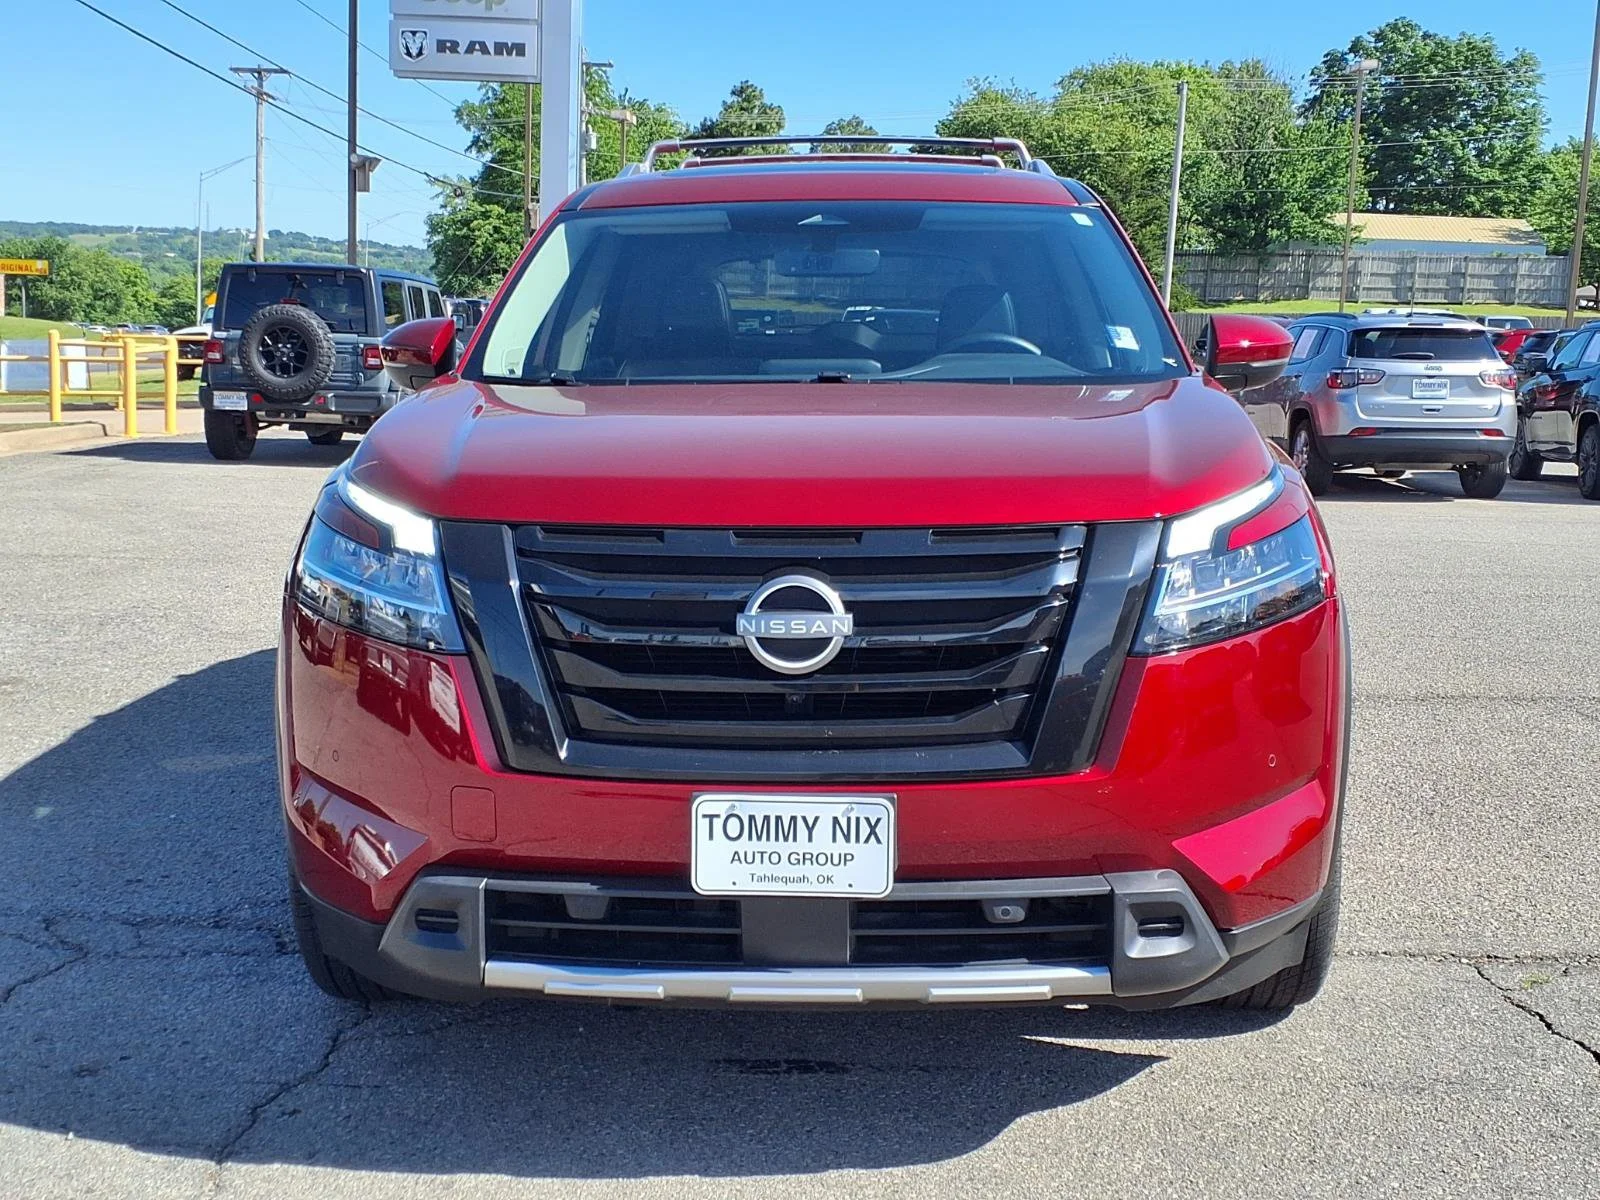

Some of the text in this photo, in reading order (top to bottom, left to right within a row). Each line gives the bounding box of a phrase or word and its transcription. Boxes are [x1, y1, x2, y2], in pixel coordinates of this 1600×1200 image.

[436, 39, 526, 57] RAM
[740, 619, 848, 634] NISSAN
[702, 813, 883, 845] TOMMY NIX
[730, 850, 855, 867] AUTO GROUP
[749, 873, 834, 886] Tahlequah, OK
